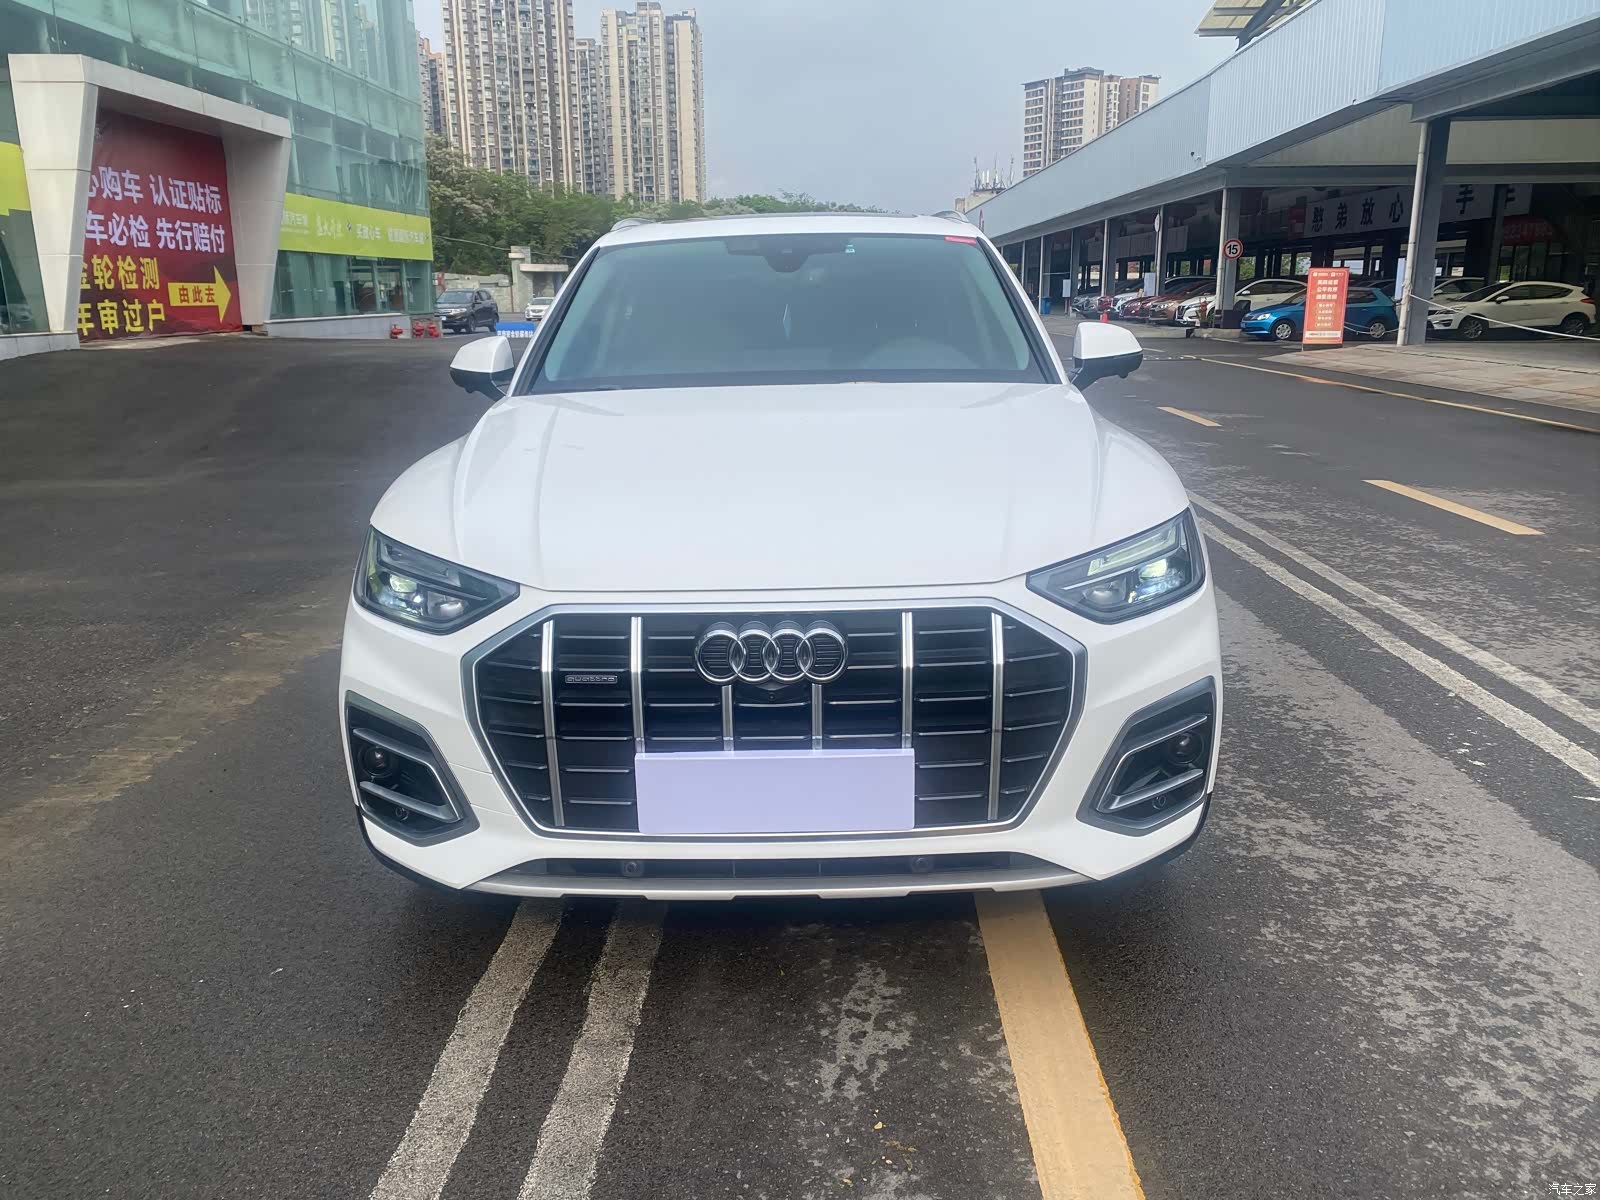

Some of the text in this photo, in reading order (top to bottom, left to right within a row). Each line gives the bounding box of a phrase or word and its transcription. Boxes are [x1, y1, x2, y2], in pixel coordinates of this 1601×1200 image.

[149, 174, 222, 214] 认证贴标
[156, 218, 225, 254] 先行赔付
[1227, 244, 1238, 255] 15
[178, 285, 216, 304] 由此去
[566, 675, 616, 683] quattro
